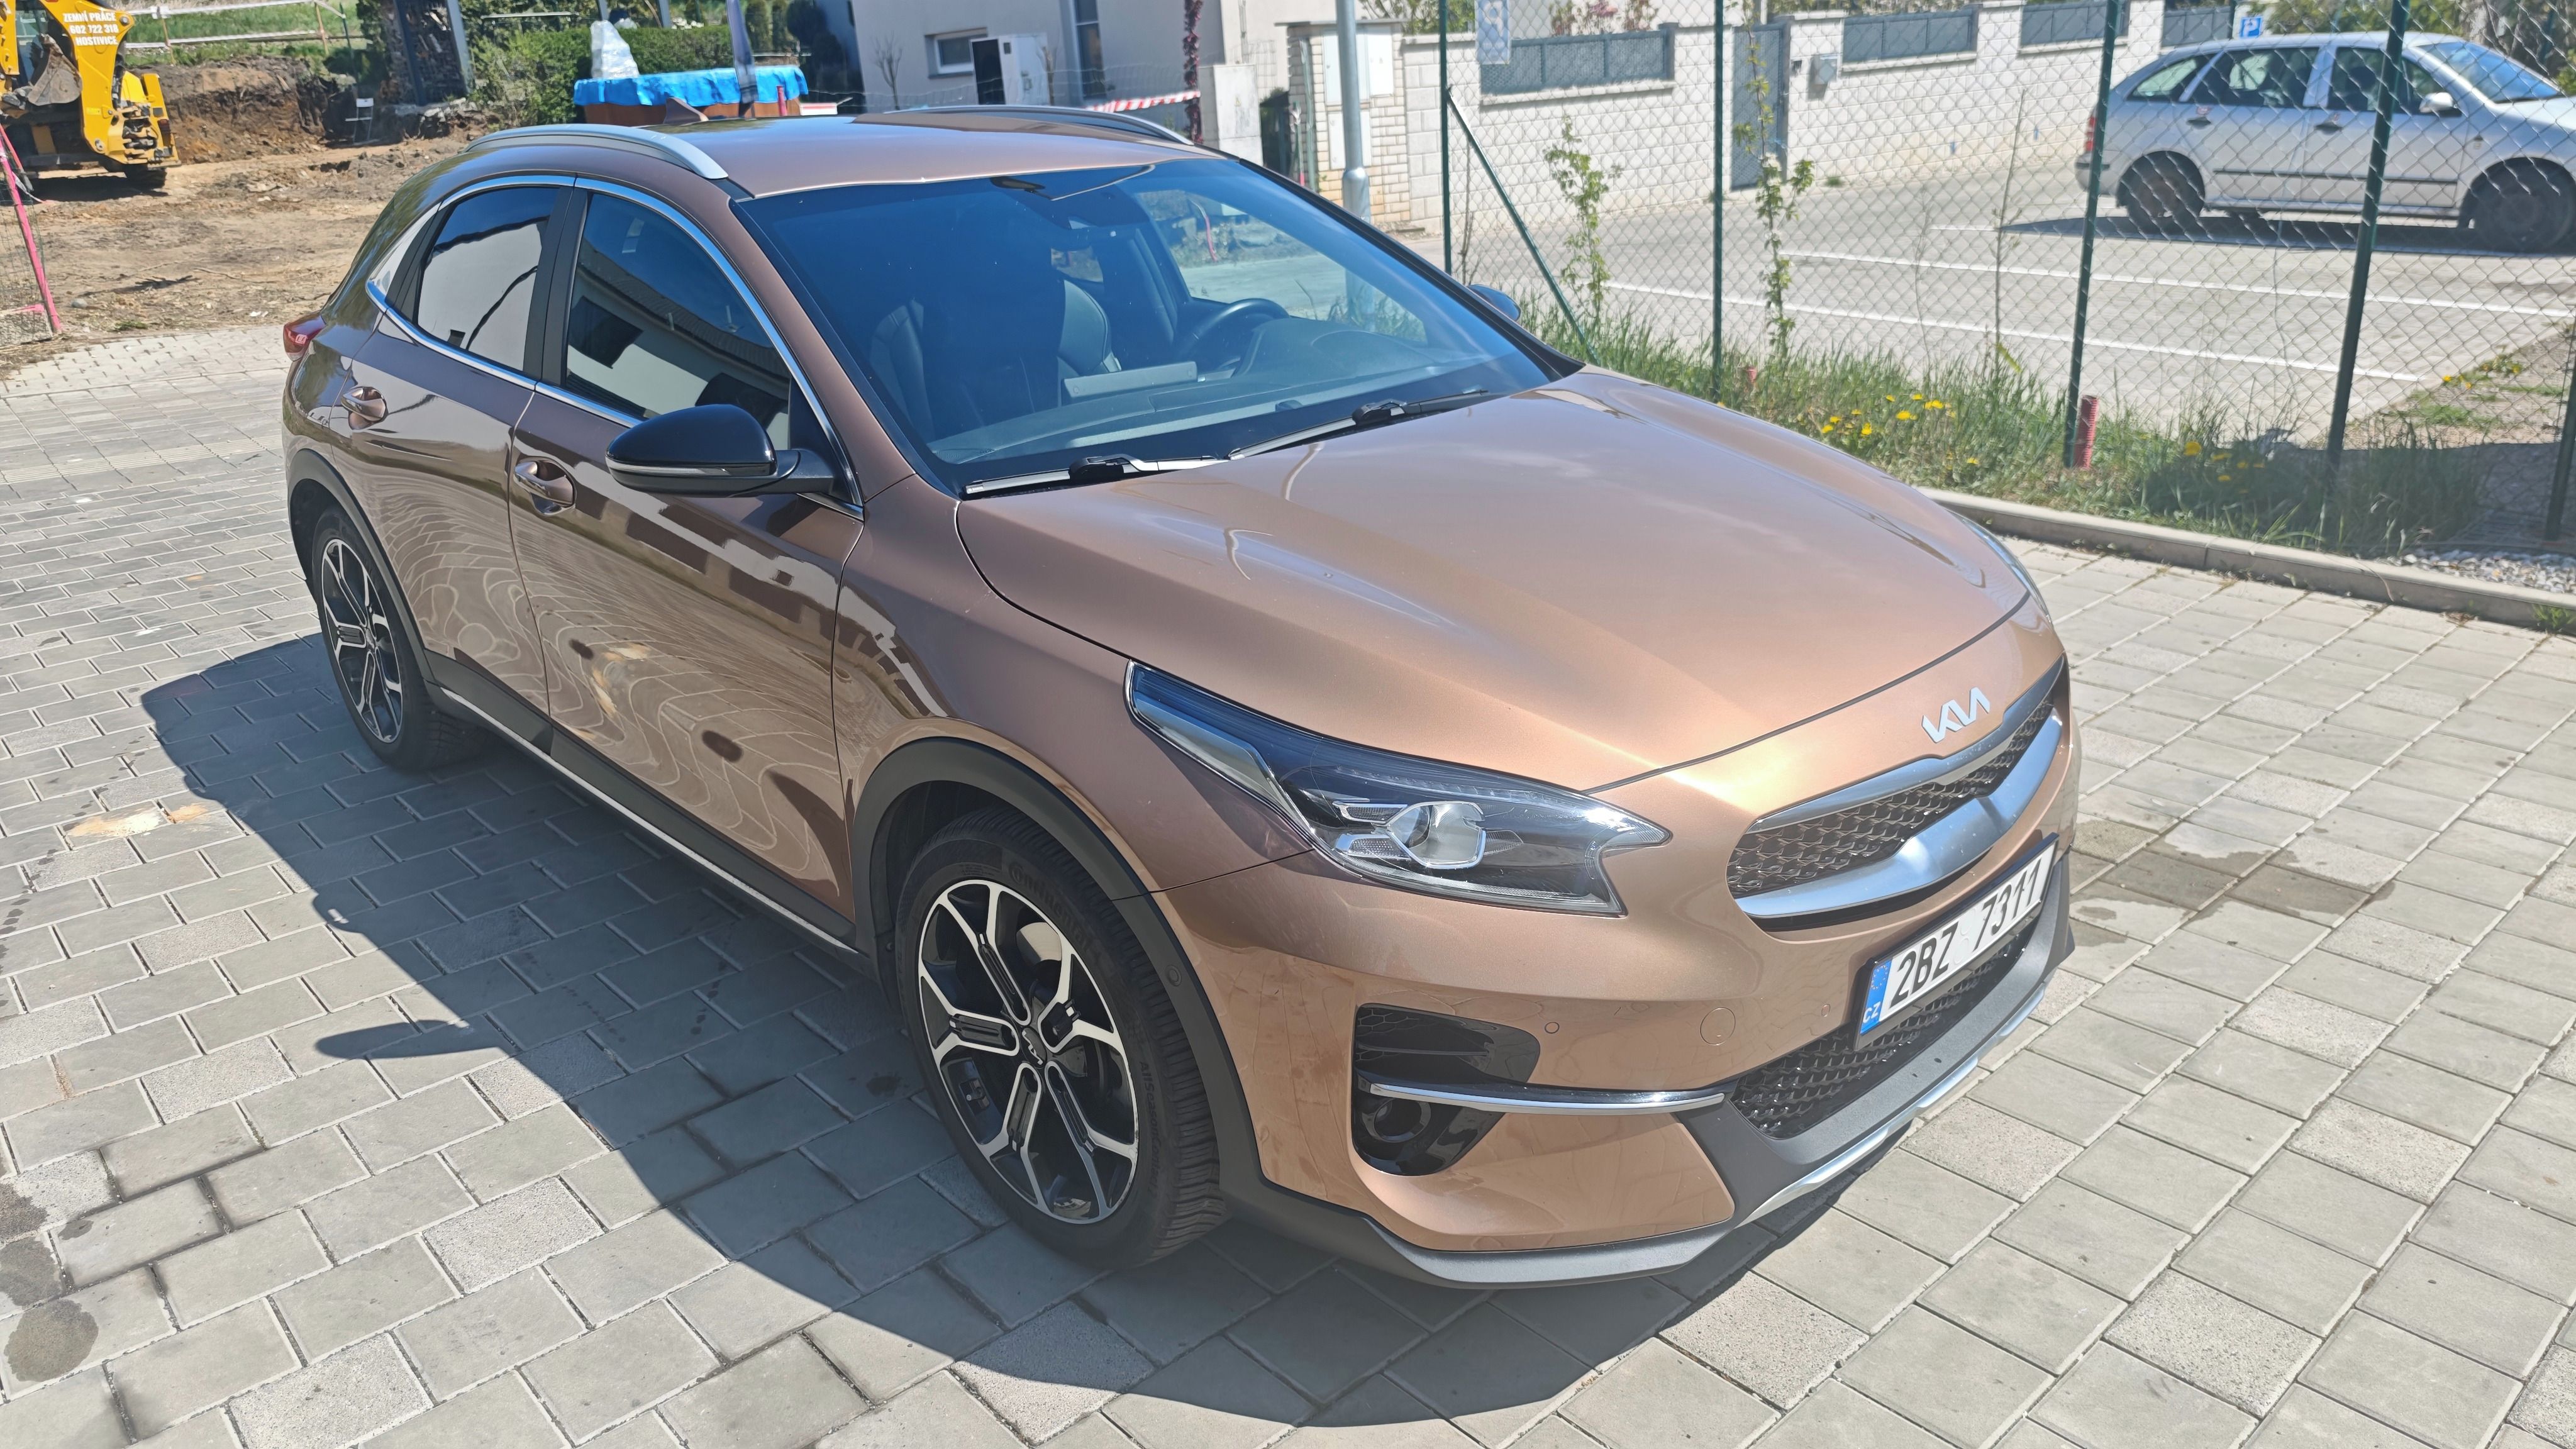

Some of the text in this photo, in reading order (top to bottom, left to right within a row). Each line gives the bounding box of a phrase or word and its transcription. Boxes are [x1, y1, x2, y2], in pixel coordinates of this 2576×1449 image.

[89, 11, 116, 21] PRÁCE
[70, 25, 87, 34] 602
[104, 24, 119, 33] 318
[75, 36, 118, 46] HOSTIVICE
[1921, 686, 1990, 743] KIA
[1889, 857, 2043, 1009] 2BZ 7311
[1862, 1001, 1881, 1023] CZ
